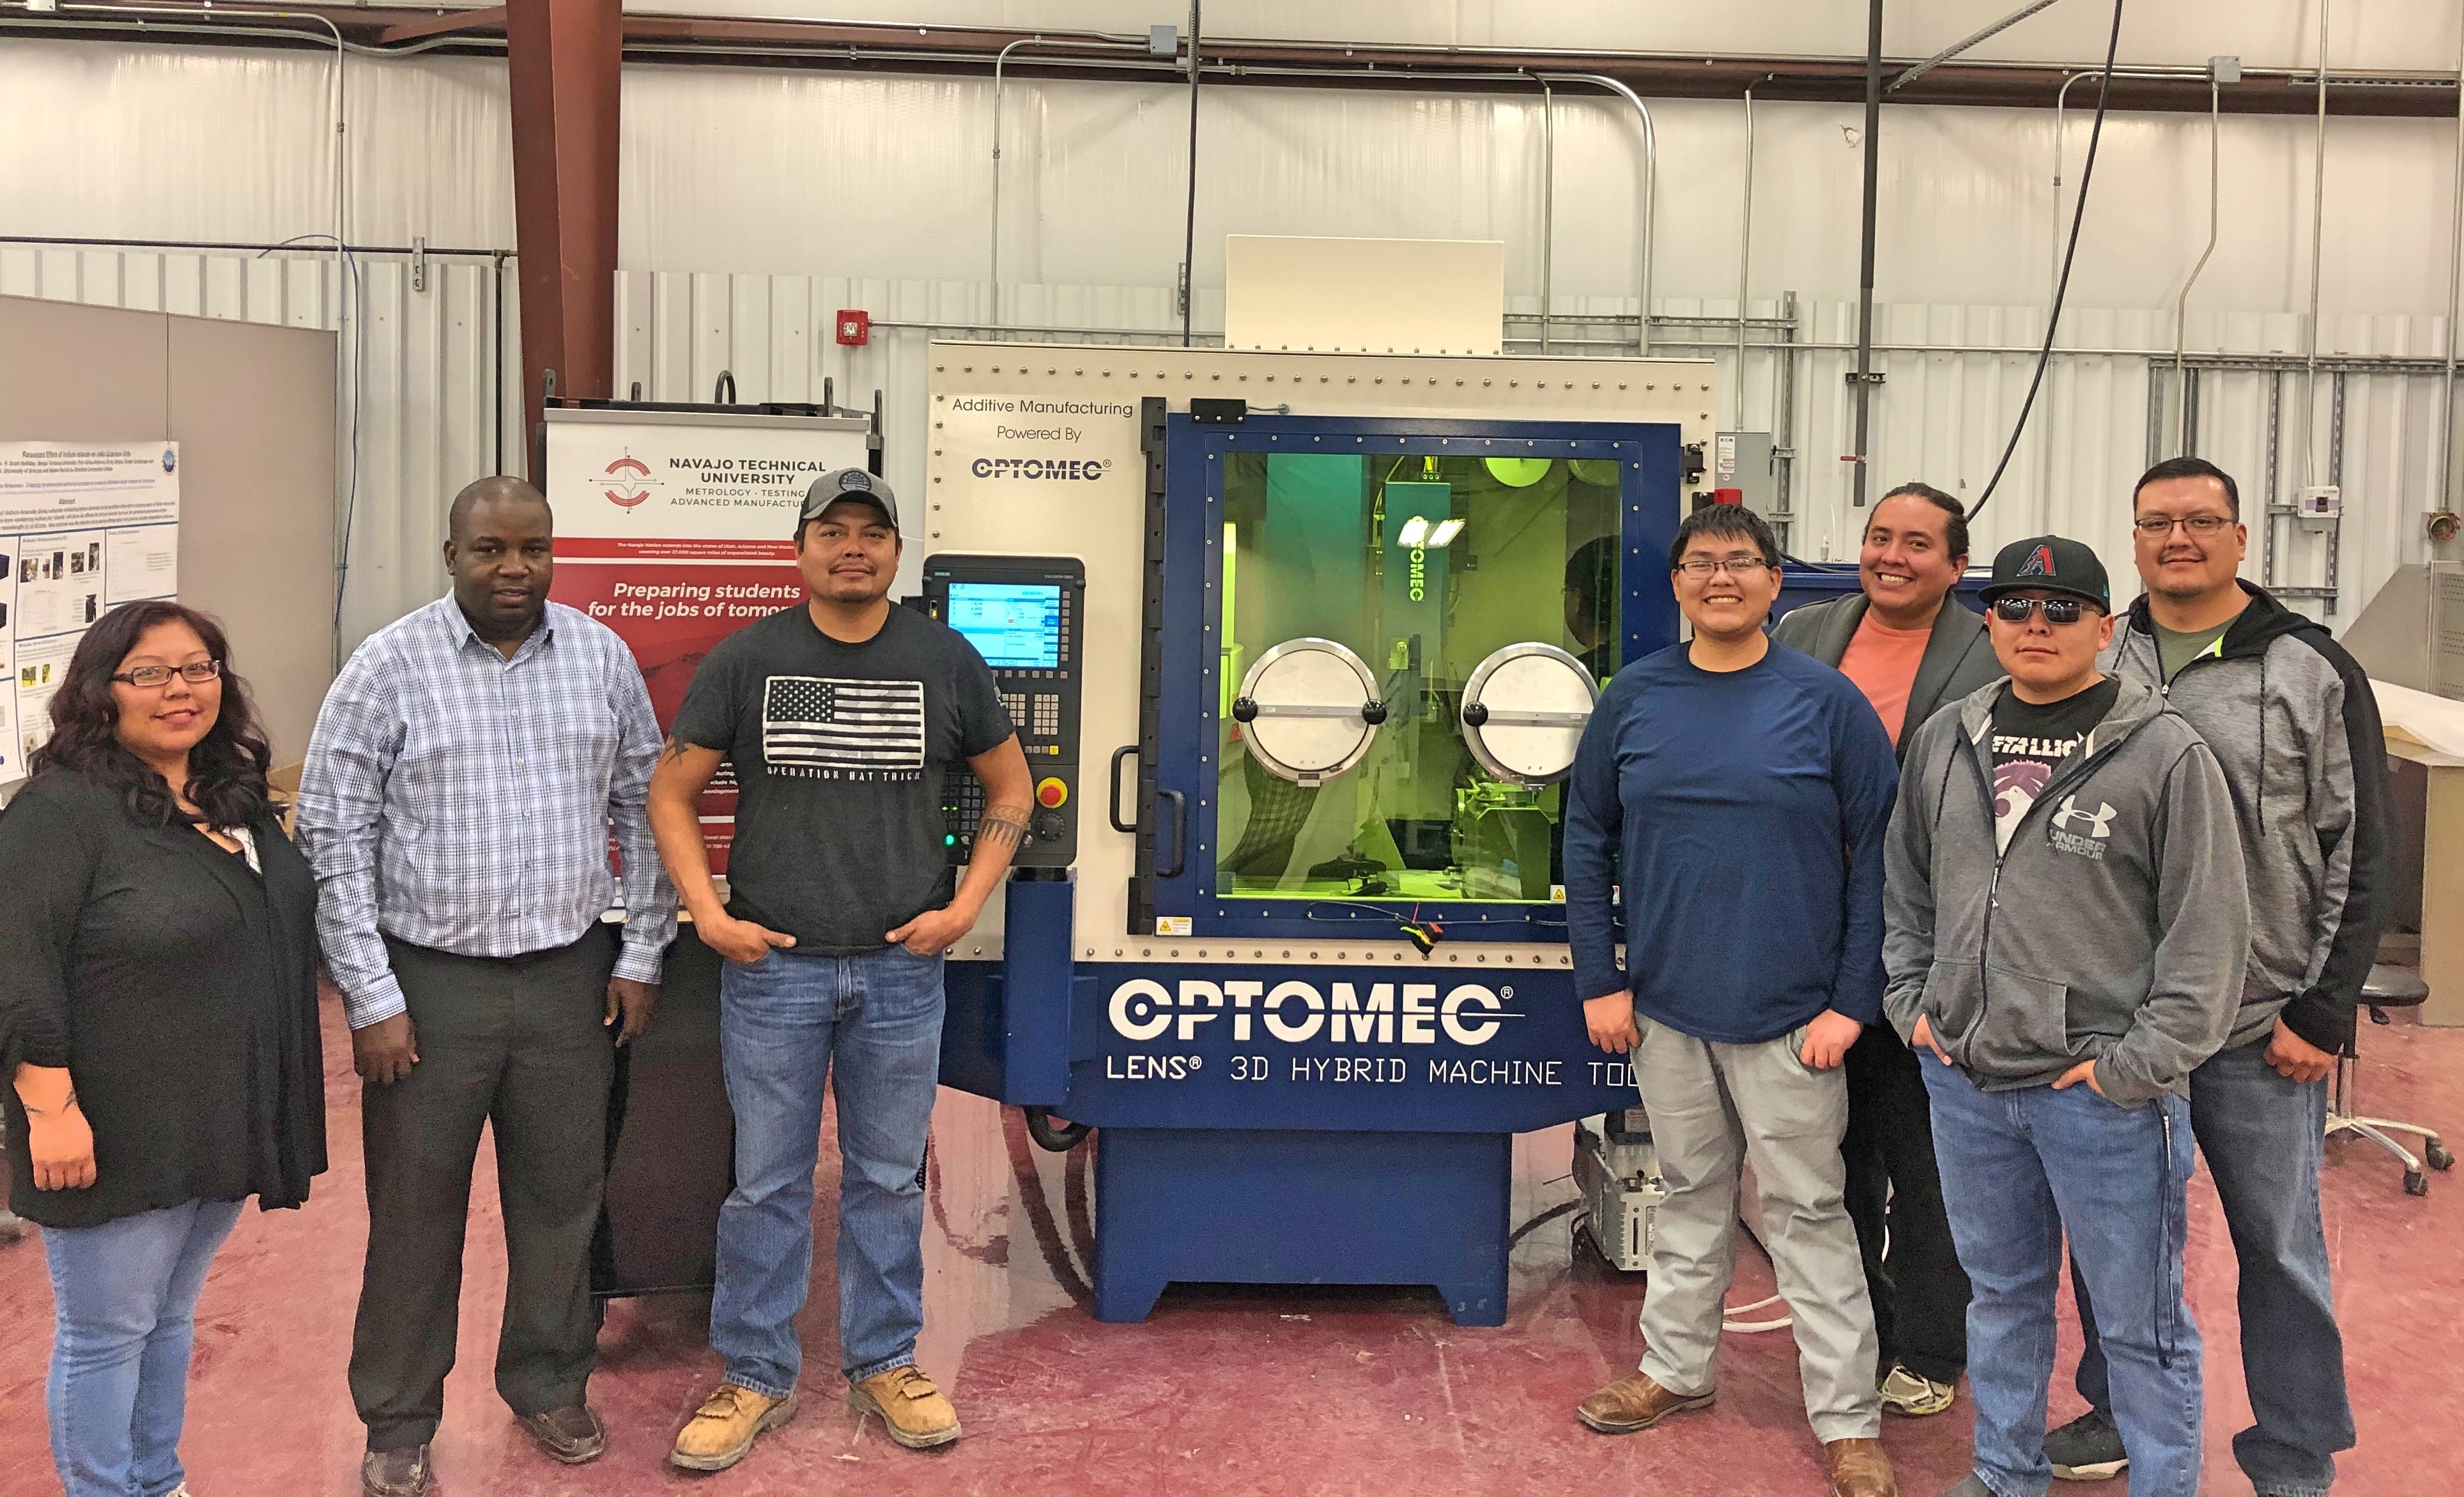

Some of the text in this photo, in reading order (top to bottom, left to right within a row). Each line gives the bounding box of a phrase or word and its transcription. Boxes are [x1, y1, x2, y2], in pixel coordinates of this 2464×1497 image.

[952, 399, 1133, 418] Additive Manufacturing
[997, 426, 1082, 443] Powered By
[670, 458, 826, 472] NAVAJO TECHNICAL
[701, 473, 796, 485] UNIVERSITY
[614, 582, 801, 601] Preparing students
[589, 601, 792, 620] for the jobs of tomo
[1992, 730, 2084, 757] ETALLIC
[767, 767, 921, 781] OPERATION HAT TRICK
[2049, 829, 2107, 852] UNDER
[1231, 1056, 1268, 1081] 3D
[1291, 1057, 1406, 1082] HYBRID
[1429, 1059, 1562, 1085] MACHINE
